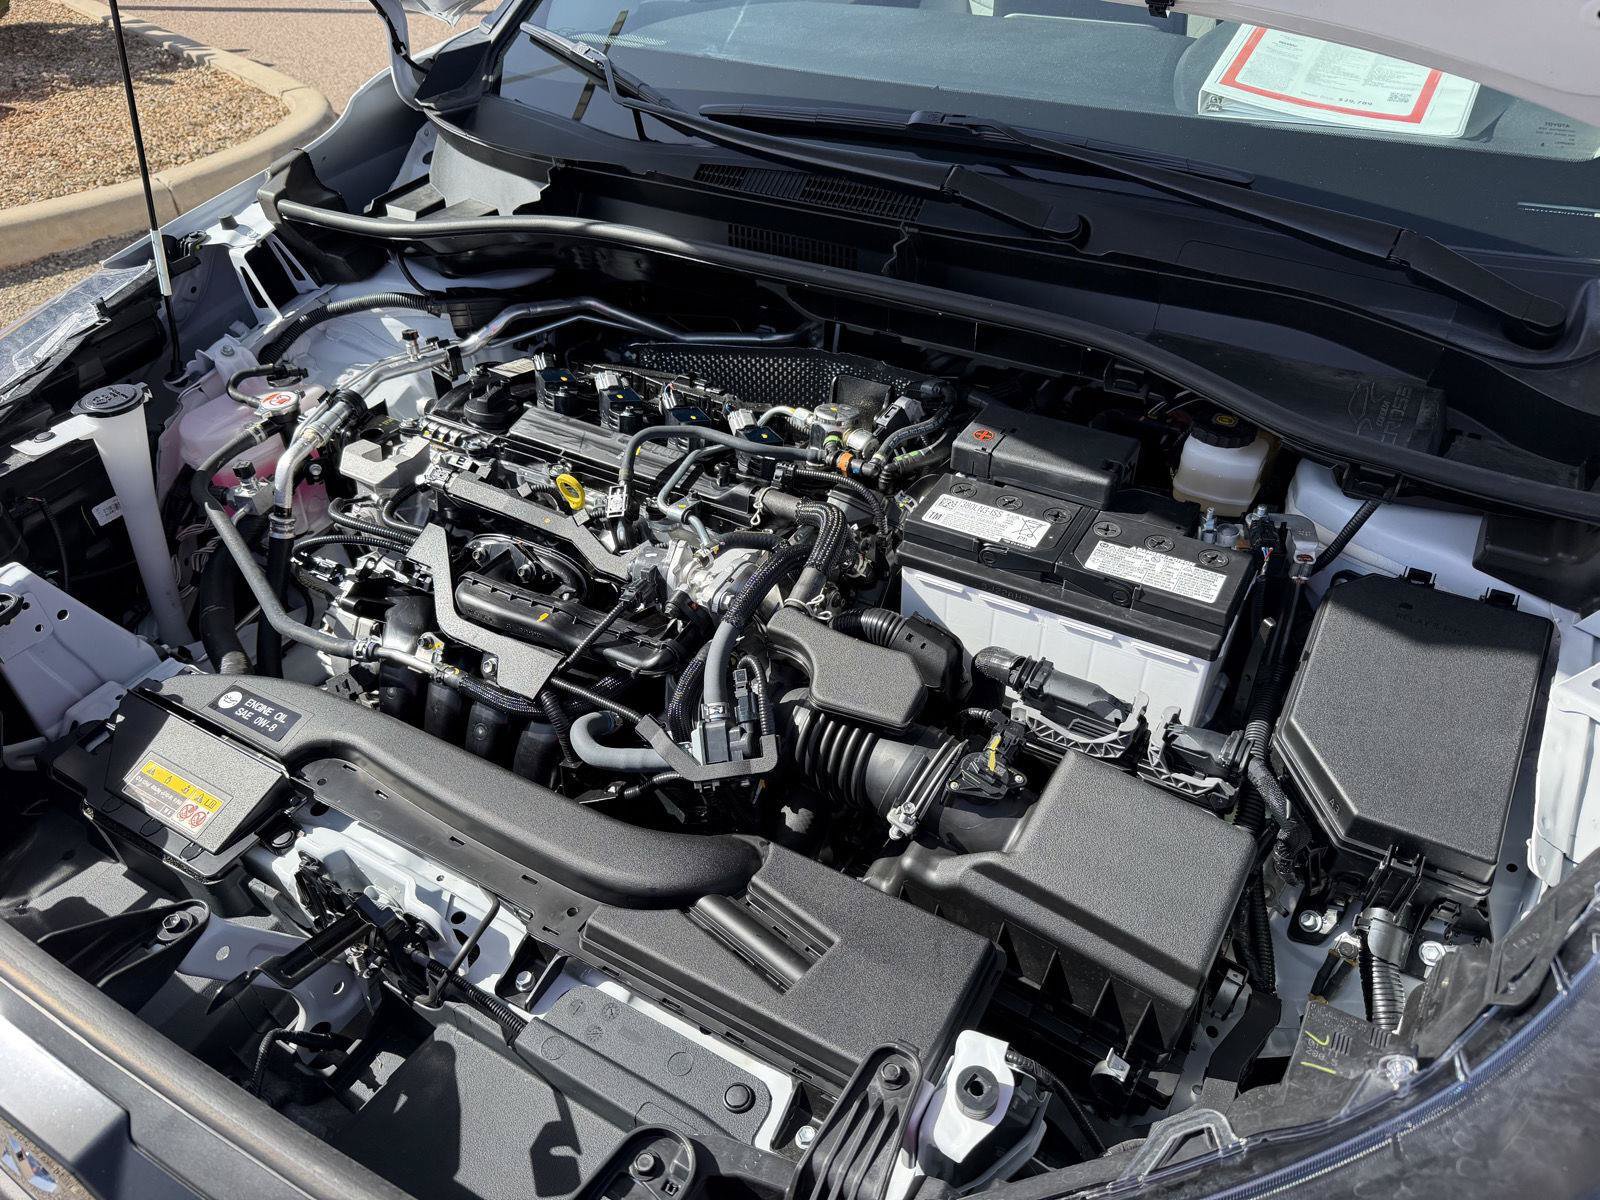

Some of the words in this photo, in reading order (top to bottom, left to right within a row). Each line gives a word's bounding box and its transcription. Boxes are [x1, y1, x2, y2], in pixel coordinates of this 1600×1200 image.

[235, 707, 254, 720] SAE
[254, 716, 278, 732] 0W-8
[245, 699, 274, 716] ENGINE
[274, 712, 288, 723] OIL
